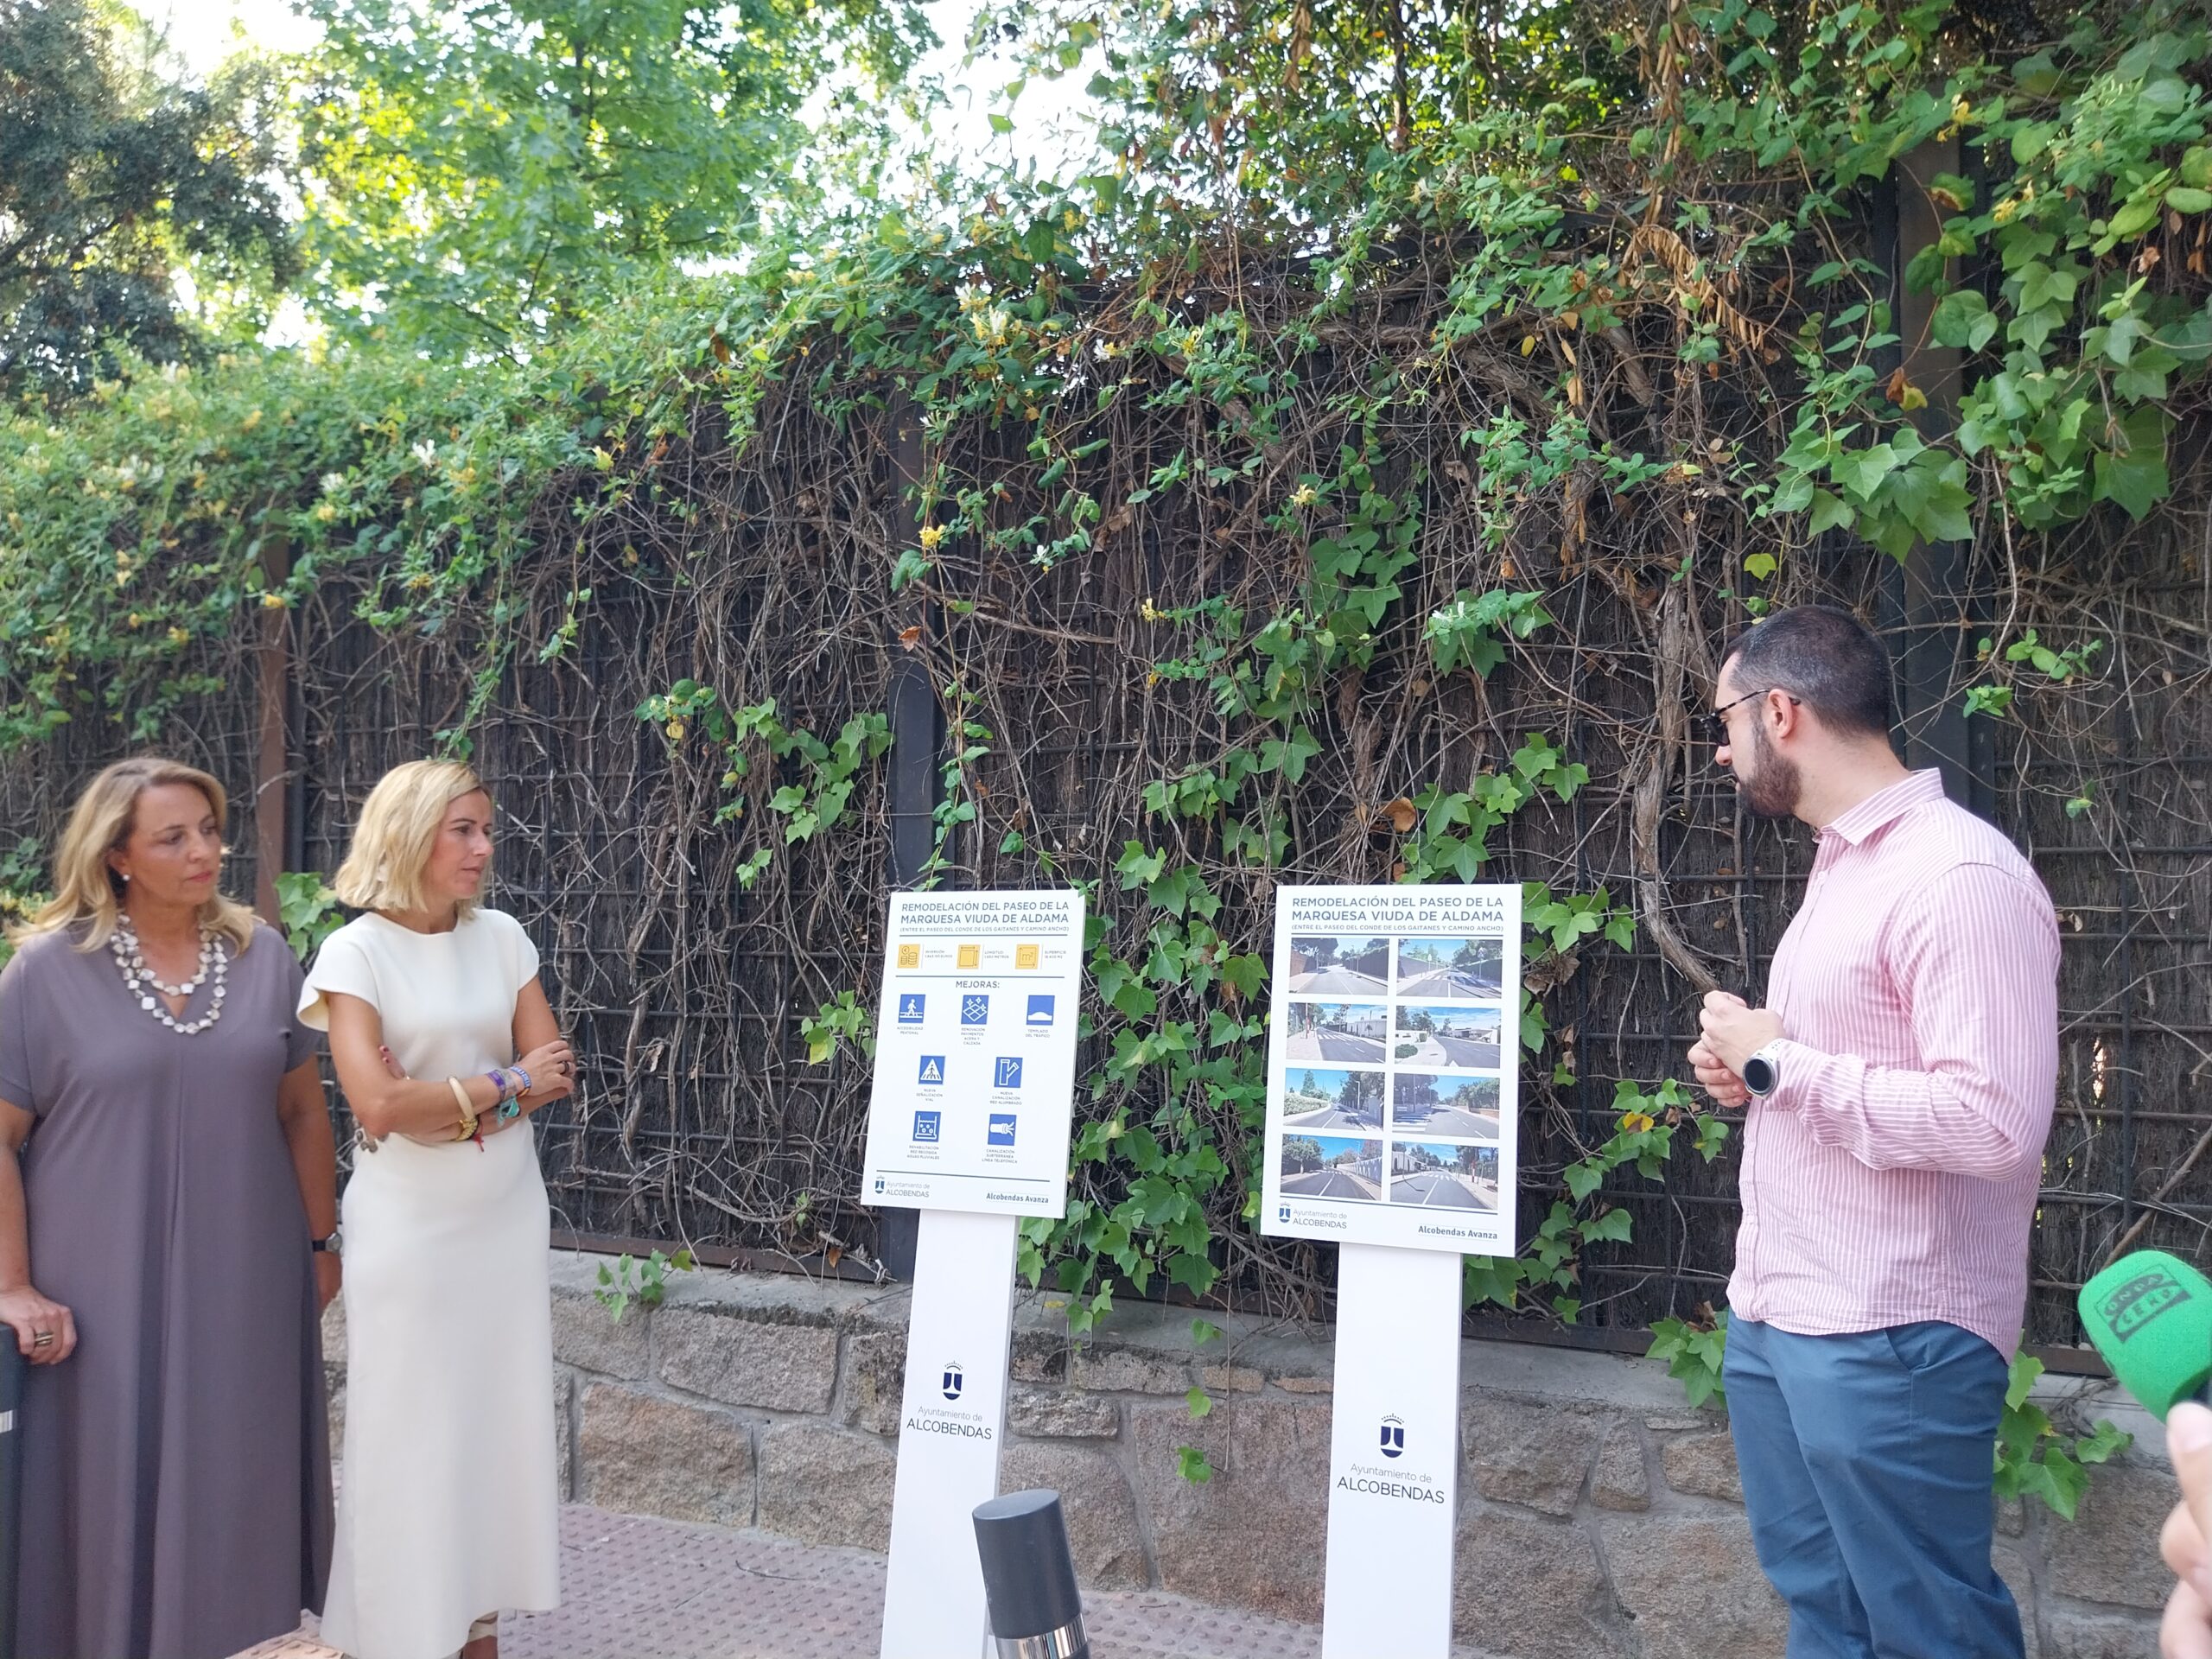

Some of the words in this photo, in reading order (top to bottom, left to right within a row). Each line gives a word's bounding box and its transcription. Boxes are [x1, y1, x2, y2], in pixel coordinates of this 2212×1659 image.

[901, 900, 979, 912] REMODELACIÓN
[982, 902, 1001, 911] DEL
[1003, 901, 1037, 910] PASEO
[1039, 901, 1053, 910] DE
[1056, 901, 1069, 910] LA
[1293, 895, 1389, 906] REMODELACIÓN
[1393, 898, 1416, 906] DEL
[1420, 897, 1462, 906] PASEO
[1465, 898, 1483, 906] DE
[1487, 898, 1503, 906] LA
[900, 914, 961, 924] MARQUESA
[964, 914, 999, 924] VIUDA
[1002, 913, 1017, 923] DE
[1020, 913, 1069, 923] ALDAMA
[1292, 911, 1367, 921] MARQUESA
[1371, 911, 1414, 921] VIUDA
[1419, 911, 1437, 921] DE
[1441, 911, 1503, 921] ALDAMA
[886, 1189, 930, 1198] ALCOBENDAS
[986, 1192, 1024, 1202] Alcobendas
[1025, 1195, 1049, 1204] Avanza
[1294, 1209, 1338, 1218] Ayuntamiento
[1293, 1217, 1347, 1230] ALCOBENDAS
[1418, 1225, 1465, 1236] Alcobendas
[1468, 1230, 1497, 1240] Avanza
[918, 1406, 971, 1421] Ayuntamiento
[906, 1418, 992, 1440] ALCOBENDAS
[1350, 1463, 1417, 1481] Ayuntamiento
[1420, 1473, 1432, 1483] de
[1338, 1476, 1445, 1504] ALCOBENDAS
